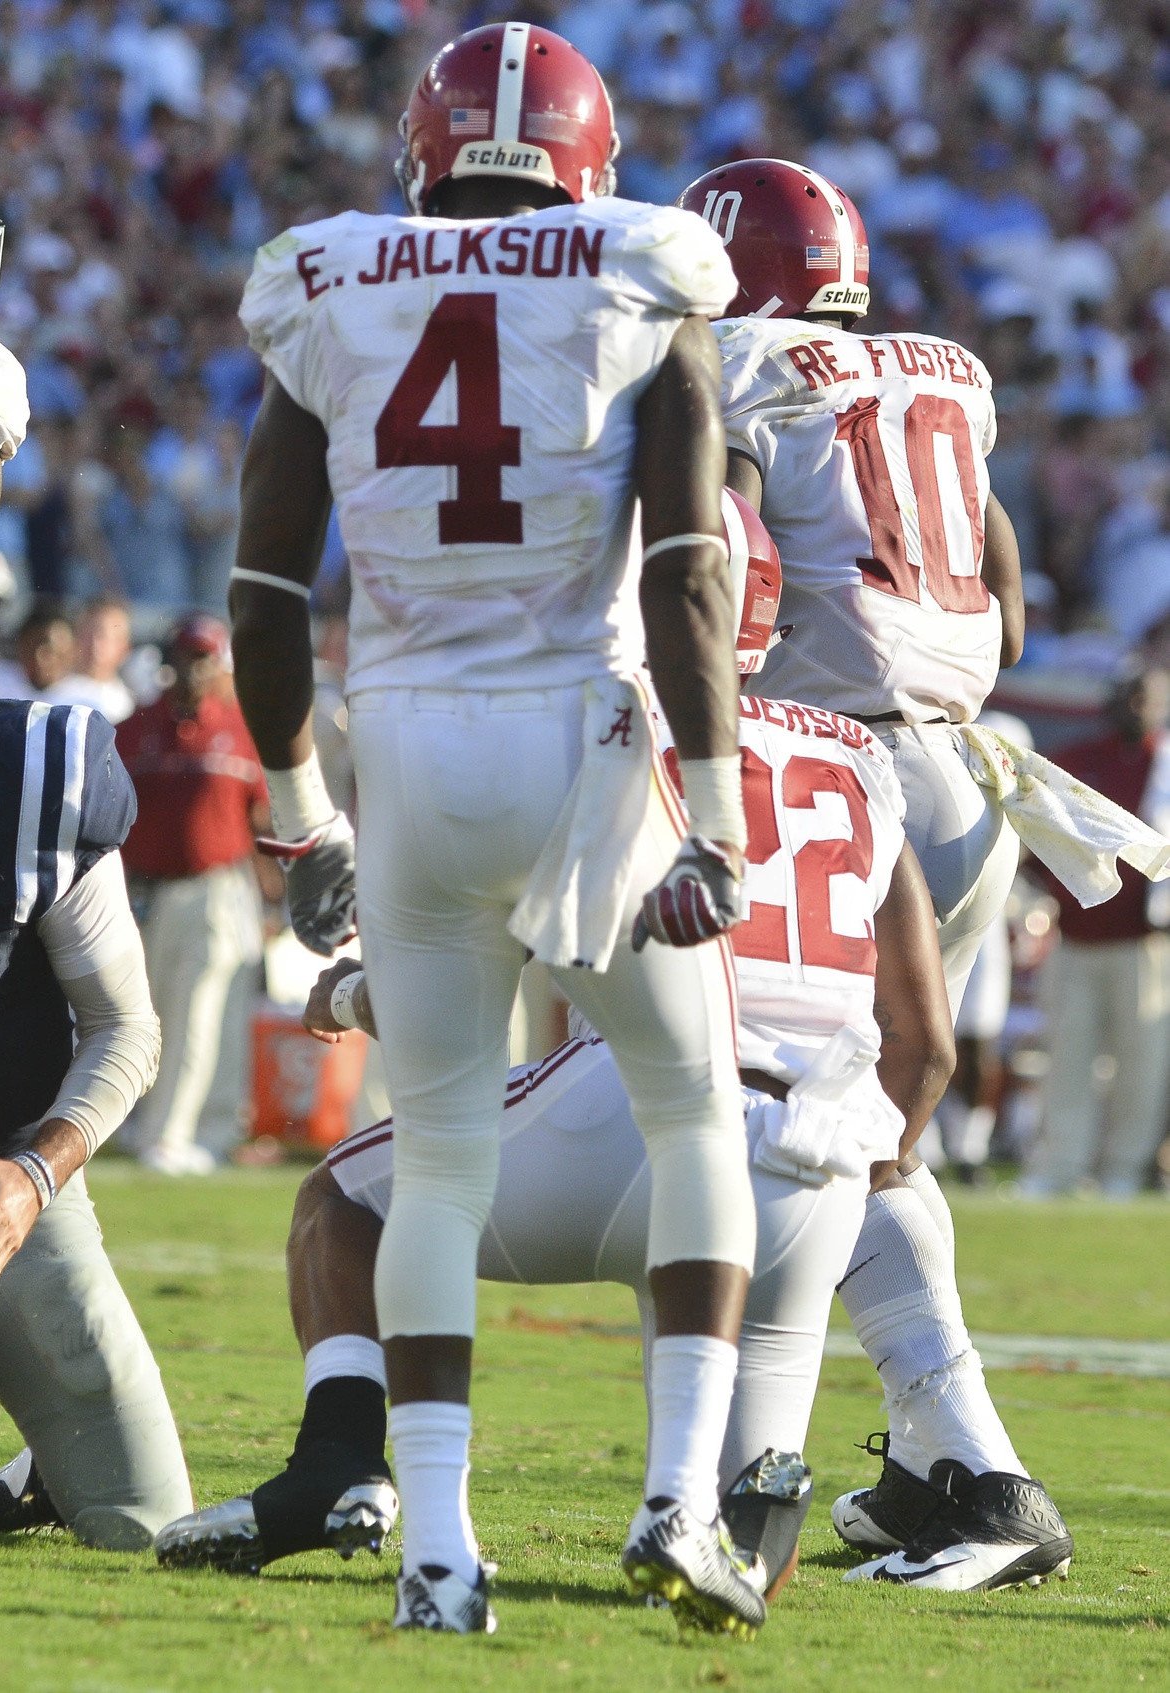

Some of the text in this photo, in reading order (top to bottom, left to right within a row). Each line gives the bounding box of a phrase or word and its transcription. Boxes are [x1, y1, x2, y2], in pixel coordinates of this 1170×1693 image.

[466, 147, 542, 169] schutt
[702, 189, 743, 247] 10
[297, 226, 607, 301] E. JACKSON
[822, 287, 869, 305] schutt
[785, 339, 860, 392] RE.
[375, 292, 524, 545] 4
[835, 393, 991, 613] 10
